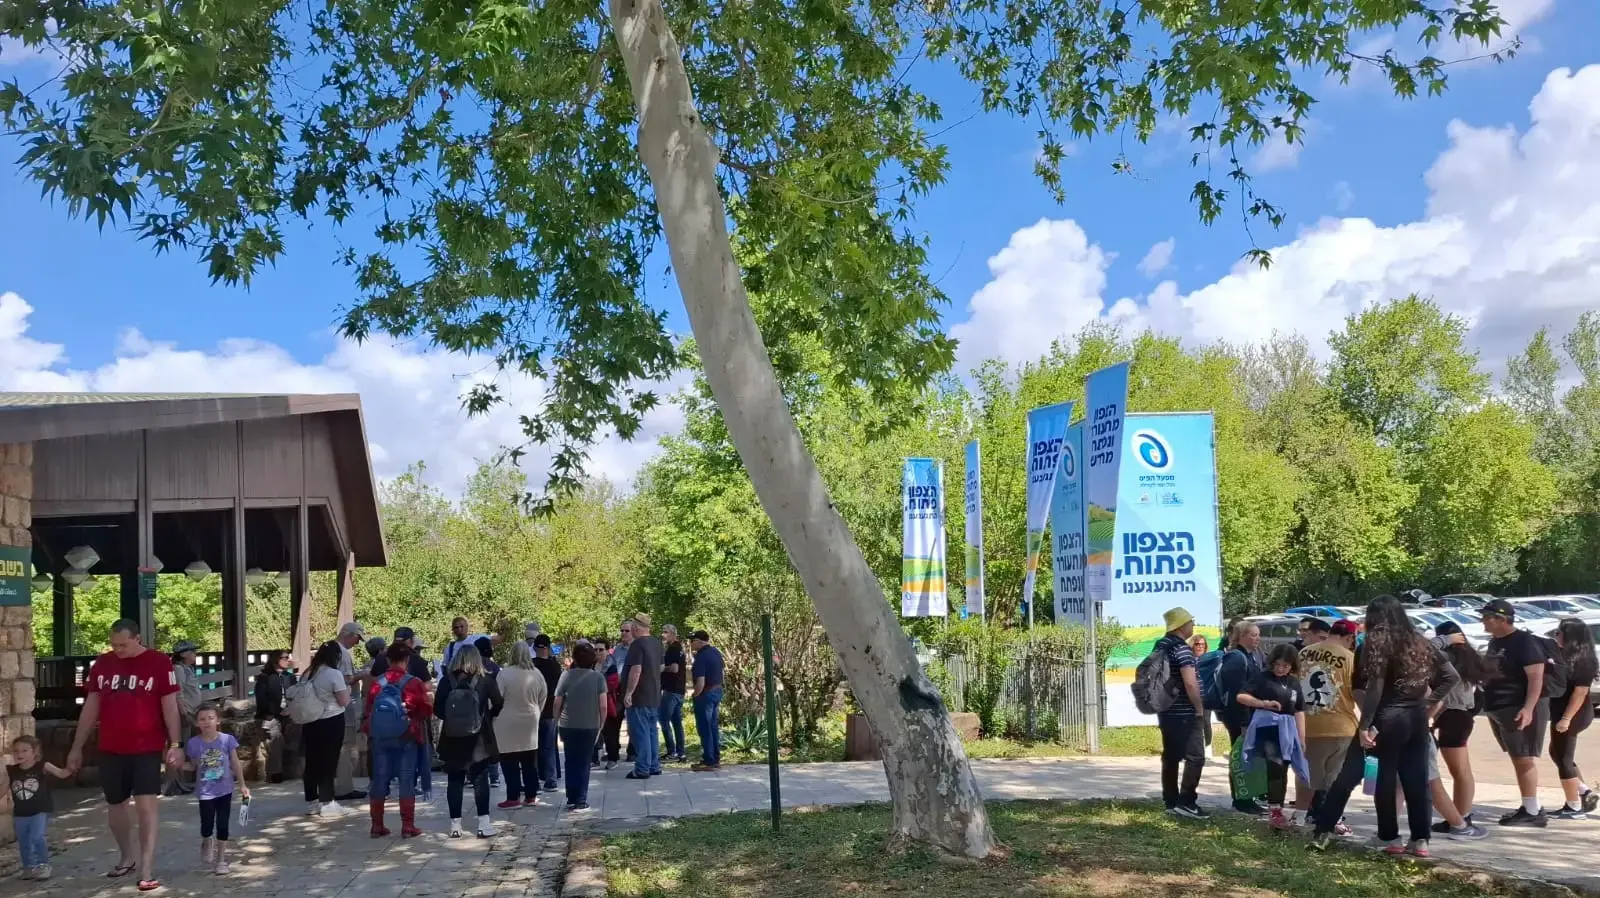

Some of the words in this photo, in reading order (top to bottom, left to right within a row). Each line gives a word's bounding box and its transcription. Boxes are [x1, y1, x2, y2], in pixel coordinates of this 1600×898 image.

[908, 486, 937, 498] הצפון
[905, 498, 937, 511] פתוח,
[1059, 532, 1082, 553] הצפון
[1123, 532, 1195, 555] הצפון
[1115, 553, 1196, 579] פתוח,
[1123, 580, 1196, 594] התגעגענו
[1300, 648, 1346, 669] SMURFS
